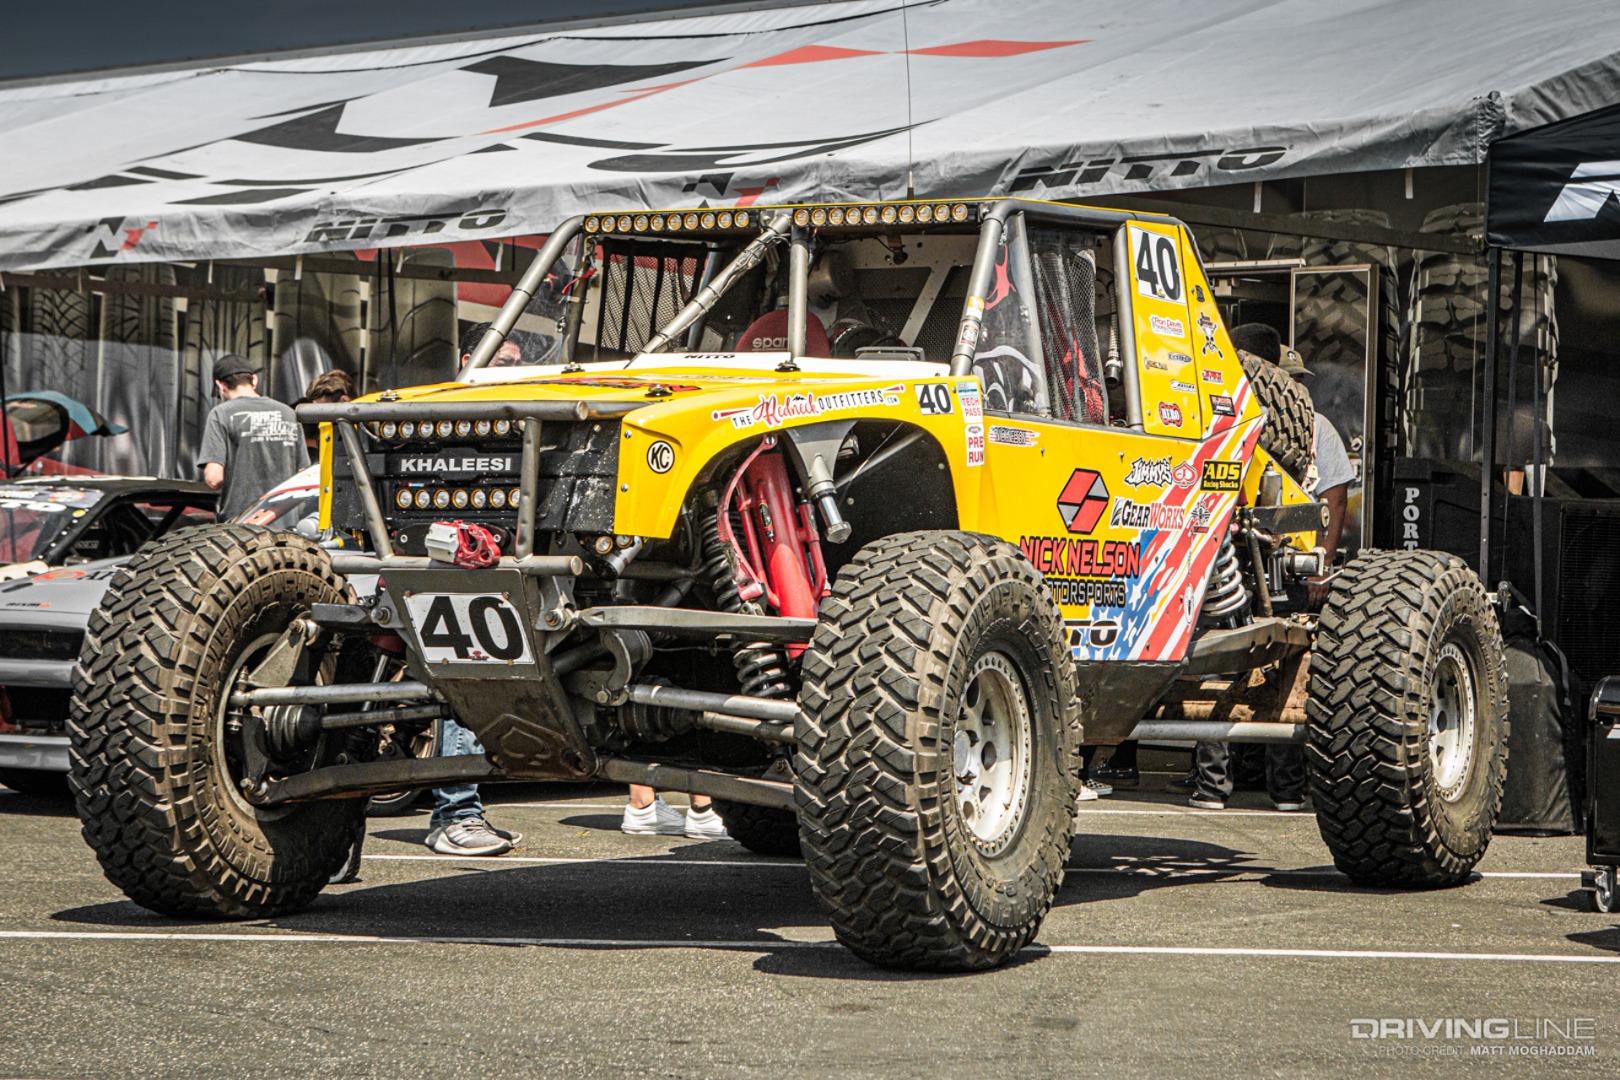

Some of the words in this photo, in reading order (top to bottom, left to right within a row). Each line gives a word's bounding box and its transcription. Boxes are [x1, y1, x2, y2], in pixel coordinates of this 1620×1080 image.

[1136, 231, 1181, 301] 40
[918, 384, 952, 414] 40
[962, 397, 980, 406] TECH
[732, 416, 752, 428] THE
[752, 394, 819, 426] Redneck
[818, 389, 884, 411] OUTFITTERS
[964, 407, 982, 417] PASS
[968, 436, 984, 449] PRE
[401, 457, 512, 472] KHALEESI
[651, 444, 671, 470] KC
[968, 451, 984, 463] RUN
[1203, 463, 1240, 480] ADS
[1203, 480, 1219, 490] Racing
[1219, 480, 1239, 489] Shocks
[1020, 535, 1066, 574] NICK
[1066, 538, 1141, 577] NELSON
[420, 595, 524, 661] 40
